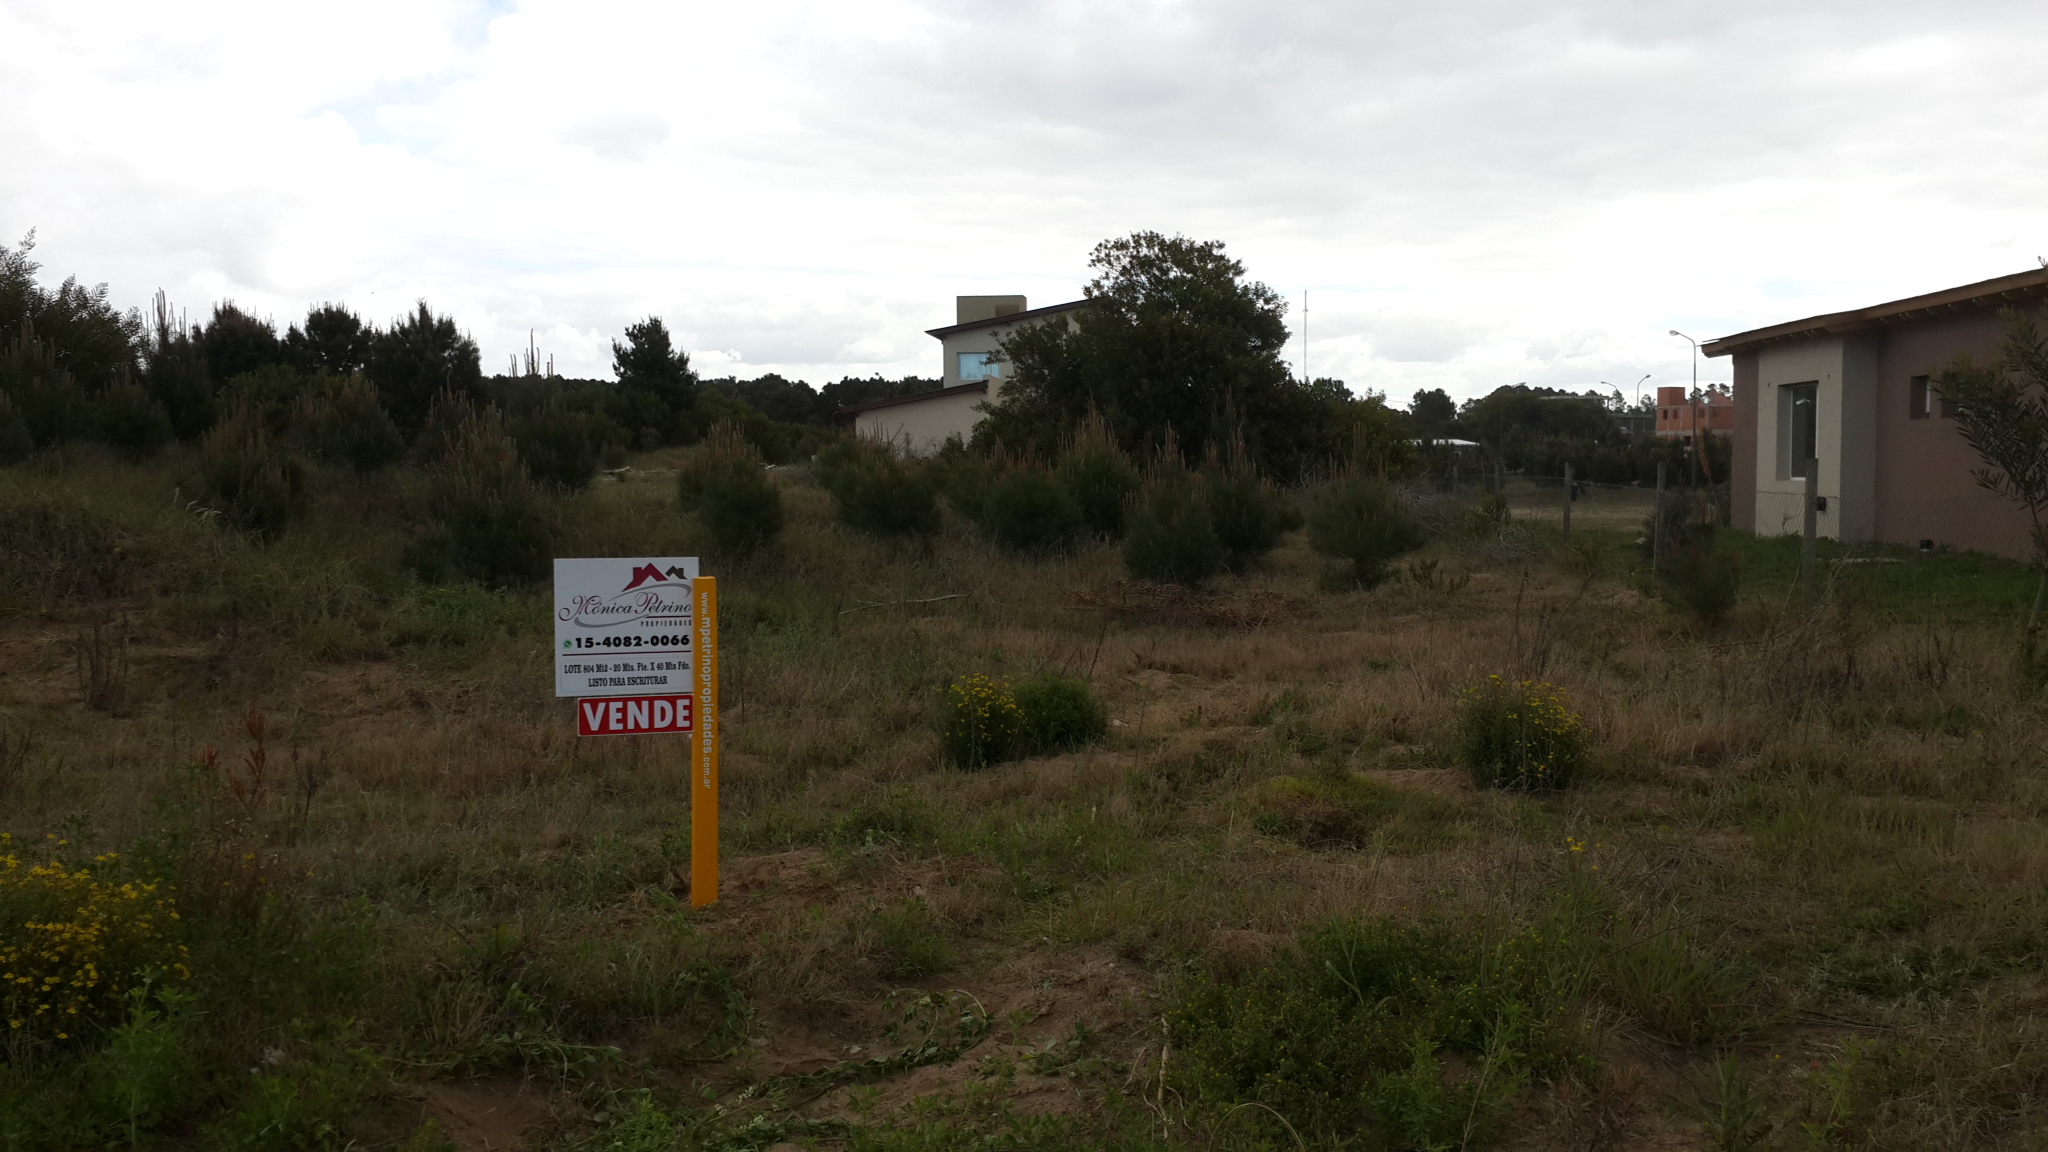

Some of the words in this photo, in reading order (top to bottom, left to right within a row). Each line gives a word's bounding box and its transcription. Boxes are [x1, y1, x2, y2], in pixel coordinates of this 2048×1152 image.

[558, 595, 632, 621] Mónica
[634, 592, 692, 614] Petrino
[575, 635, 690, 648] 15-4082-0066
[564, 665, 581, 673] LOTE
[613, 664, 621, 672] 20
[622, 663, 636, 672] Mts.
[637, 662, 649, 671] Fte.
[650, 662, 655, 670] X
[656, 662, 664, 670] 40
[677, 661, 690, 670] Fdo.
[588, 678, 608, 687] LISTO
[609, 677, 626, 686] PARA
[627, 676, 668, 685] ESCRITURAR
[700, 592, 714, 788] www.mpetrinopropiedades.com.ar
[583, 699, 691, 731] VENDE
